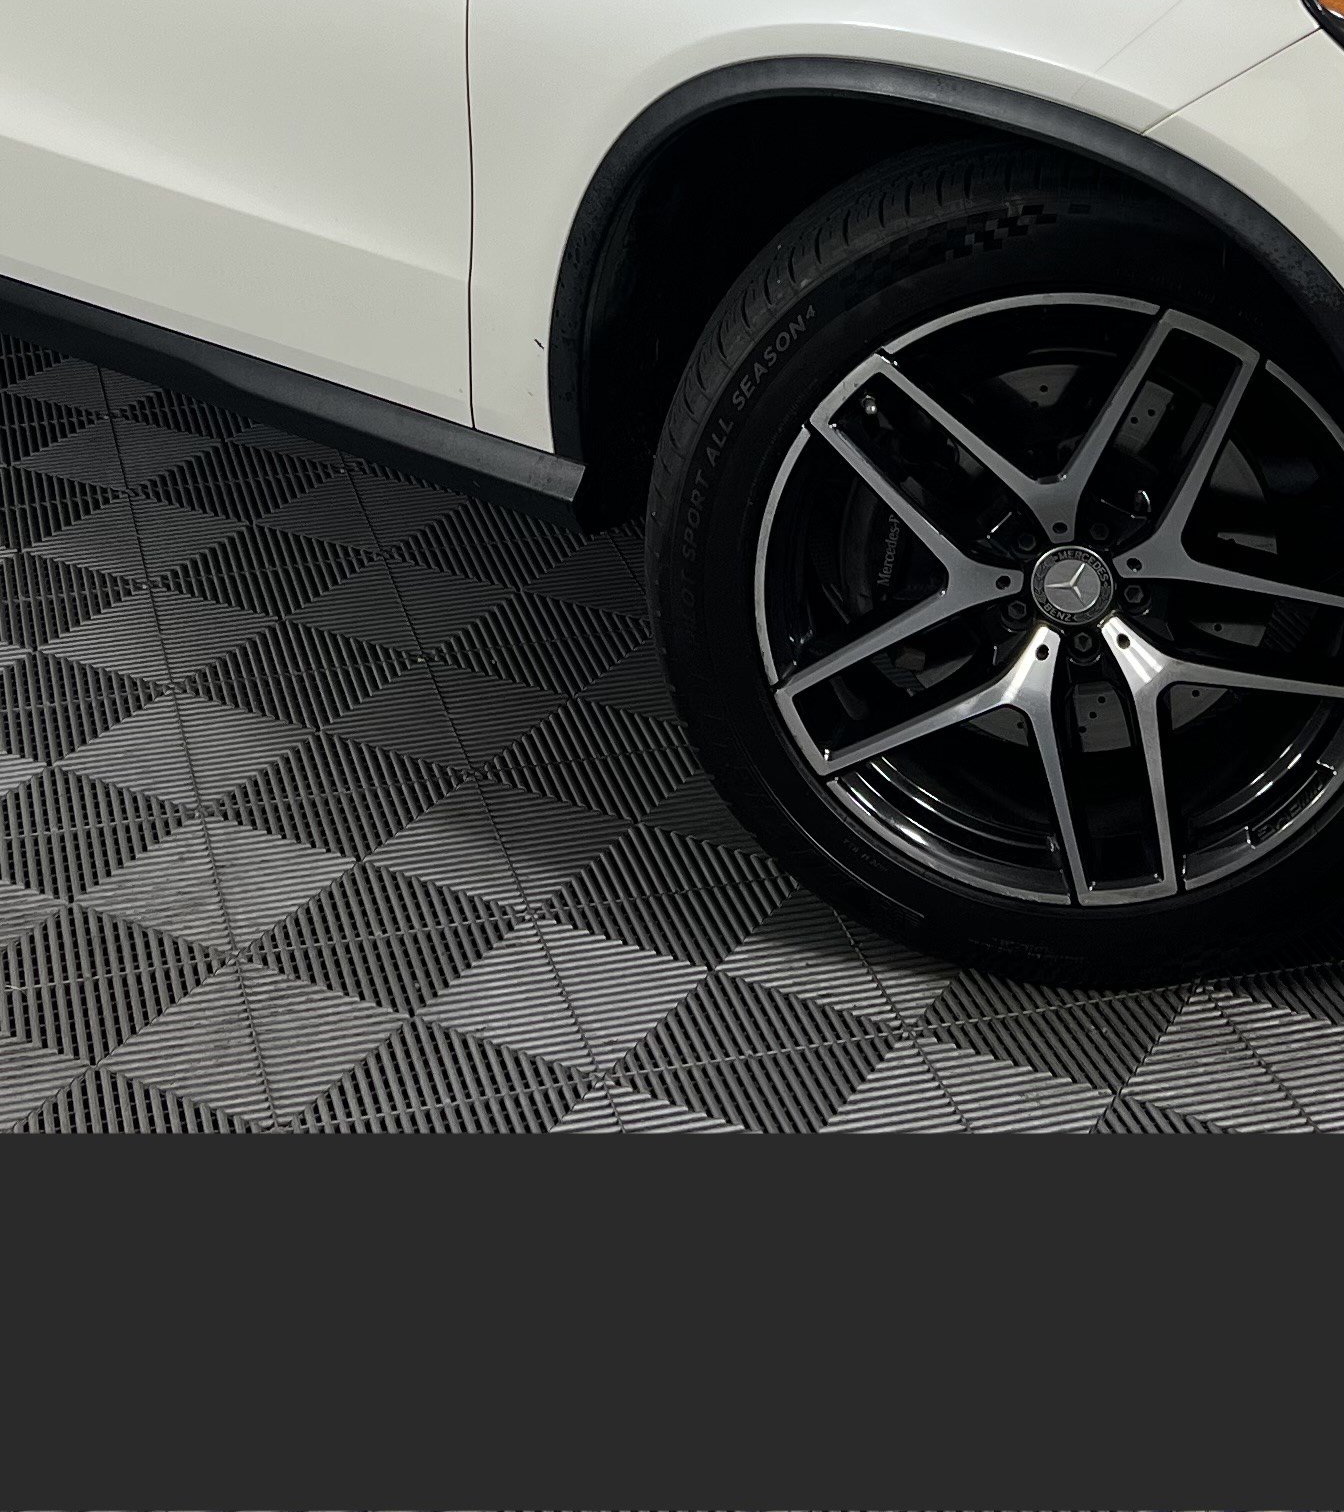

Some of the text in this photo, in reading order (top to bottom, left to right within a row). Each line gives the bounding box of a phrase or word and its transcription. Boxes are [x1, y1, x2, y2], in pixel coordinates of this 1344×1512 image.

[682, 469, 709, 562] SPORT
[706, 418, 735, 468] ALL
[732, 314, 809, 412] SEASON
[1057, 549, 1109, 582] MERCEDES
[1043, 602, 1072, 622] BENZ
